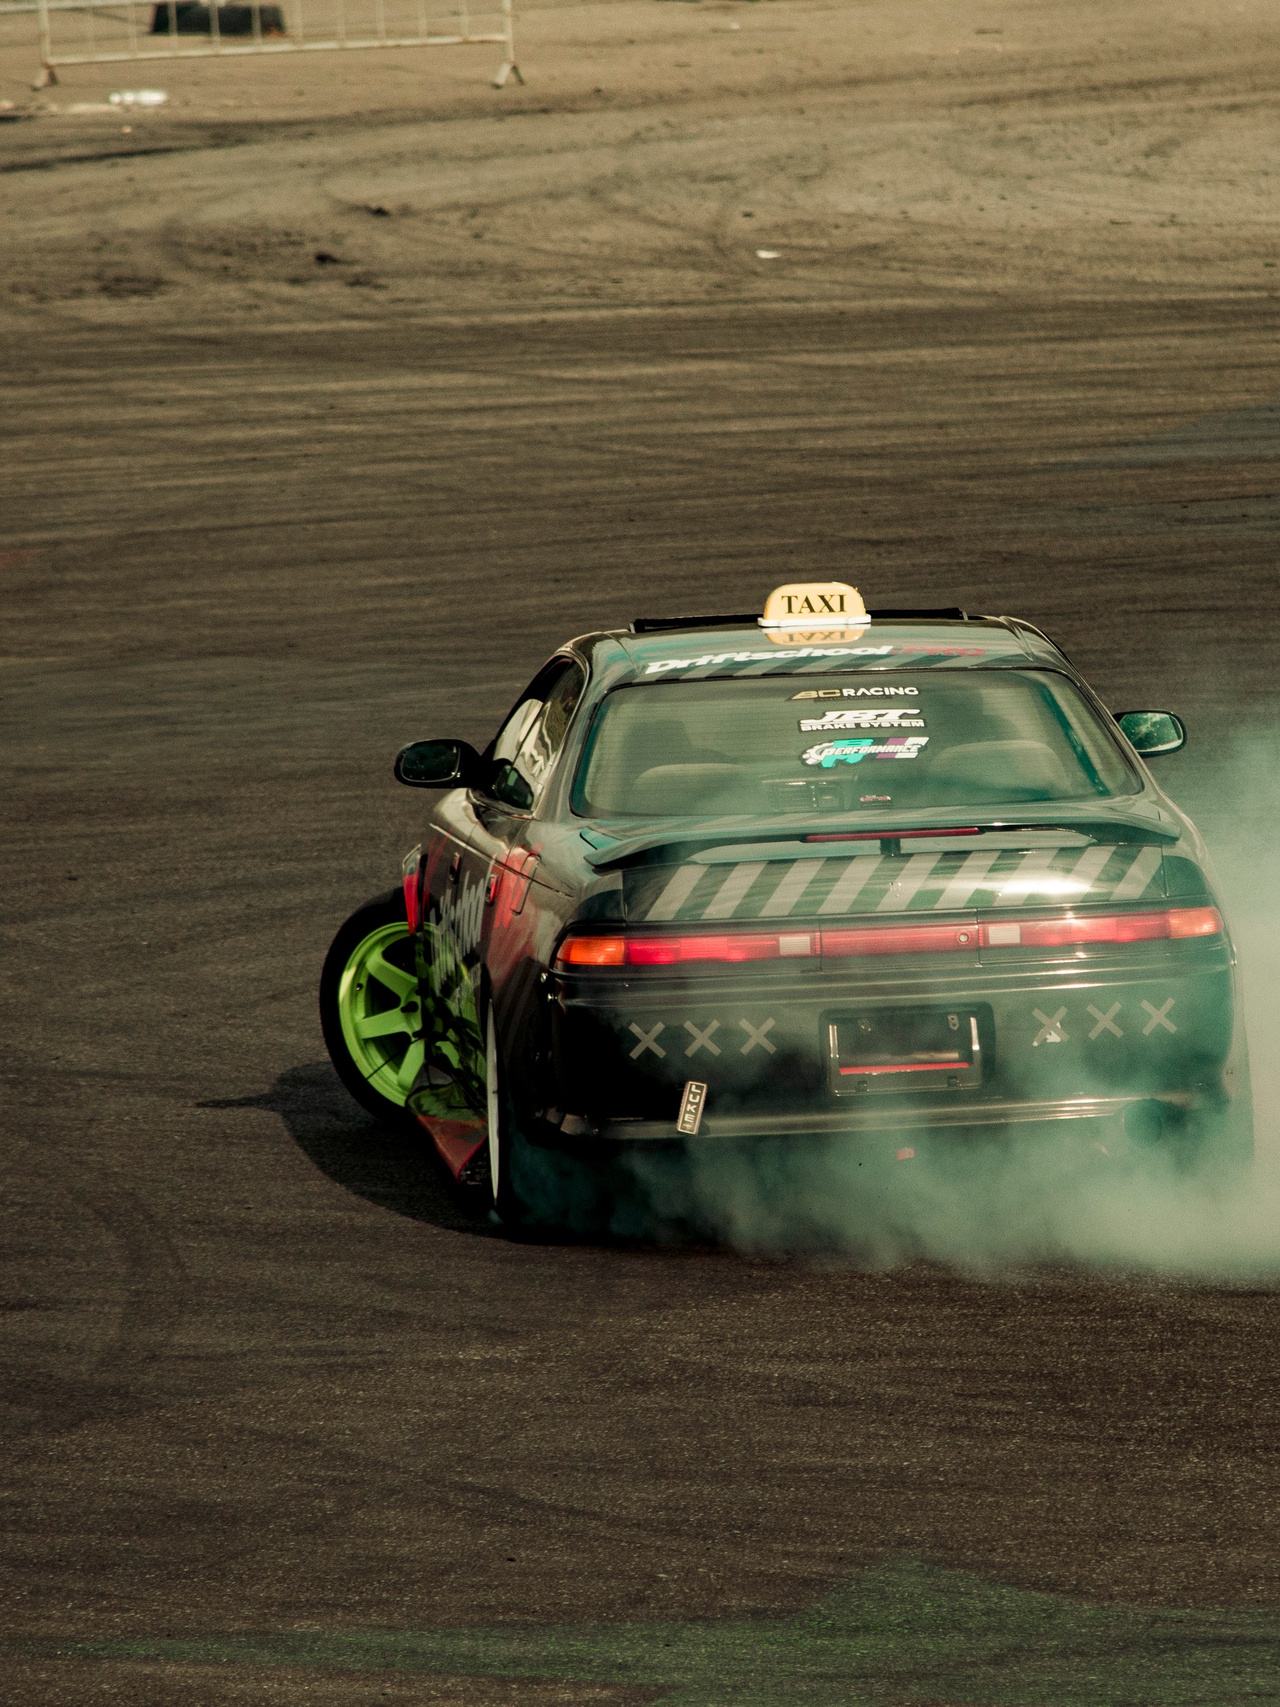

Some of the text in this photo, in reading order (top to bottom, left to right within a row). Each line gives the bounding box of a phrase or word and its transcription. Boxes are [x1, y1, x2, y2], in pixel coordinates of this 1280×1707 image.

[781, 594, 847, 614] TAXI
[842, 686, 919, 697] RACING
[801, 720, 925, 732] BRAKE SYSTEM
